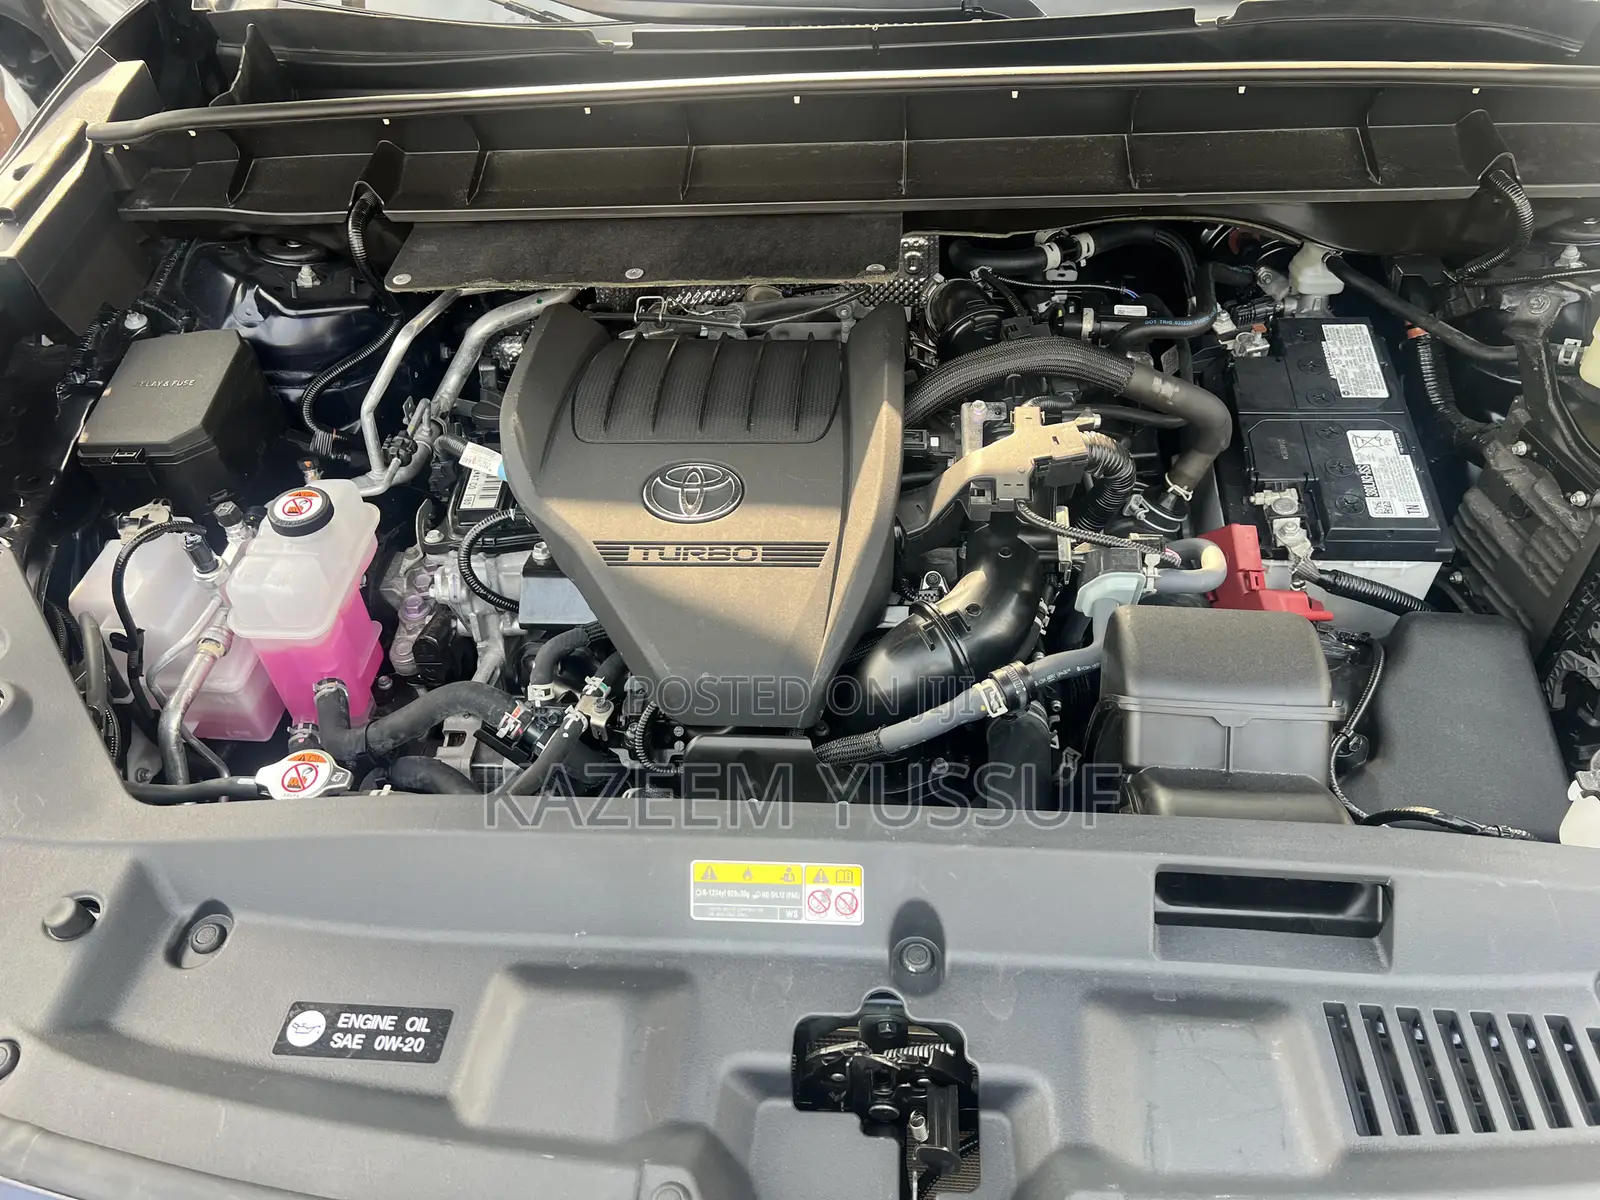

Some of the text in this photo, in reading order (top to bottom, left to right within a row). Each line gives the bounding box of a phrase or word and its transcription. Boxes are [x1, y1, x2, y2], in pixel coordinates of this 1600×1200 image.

[632, 546, 758, 562] TURBO
[786, 909, 798, 918] WS
[336, 1013, 432, 1032] ENGINE OIL
[329, 1033, 425, 1053] SAE 0W-20
